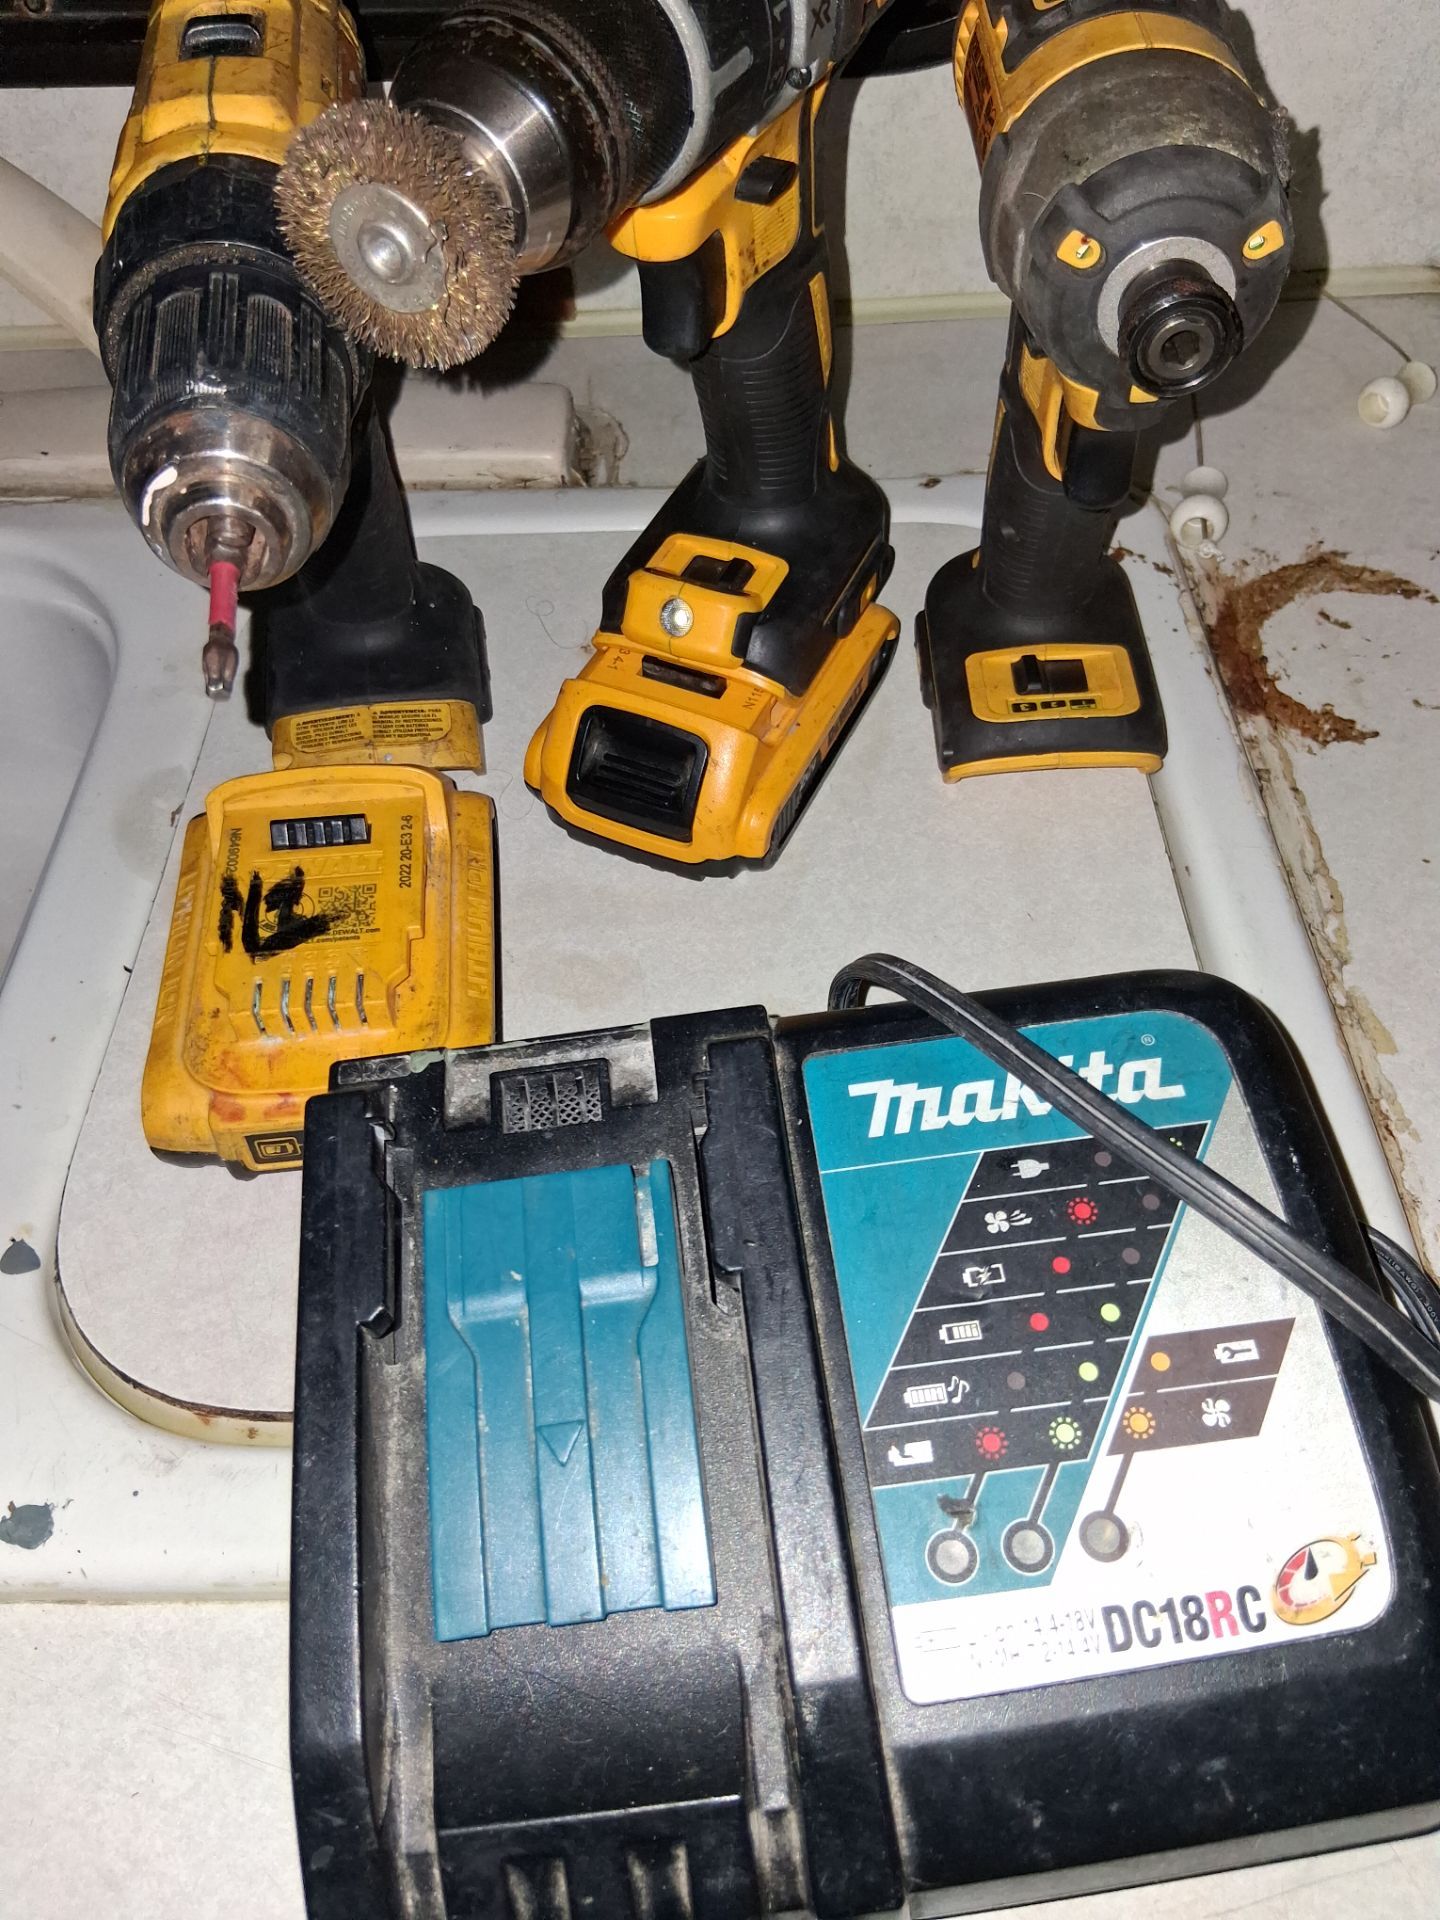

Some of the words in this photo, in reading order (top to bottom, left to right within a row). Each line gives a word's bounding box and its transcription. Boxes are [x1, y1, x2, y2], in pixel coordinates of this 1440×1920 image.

[400, 814, 413, 831] 2-6
[400, 832, 413, 861] 20-E3
[399, 863, 412, 889] 2022
[848, 1051, 1186, 1138] makta
[1101, 1584, 1267, 1653] DC18RC
